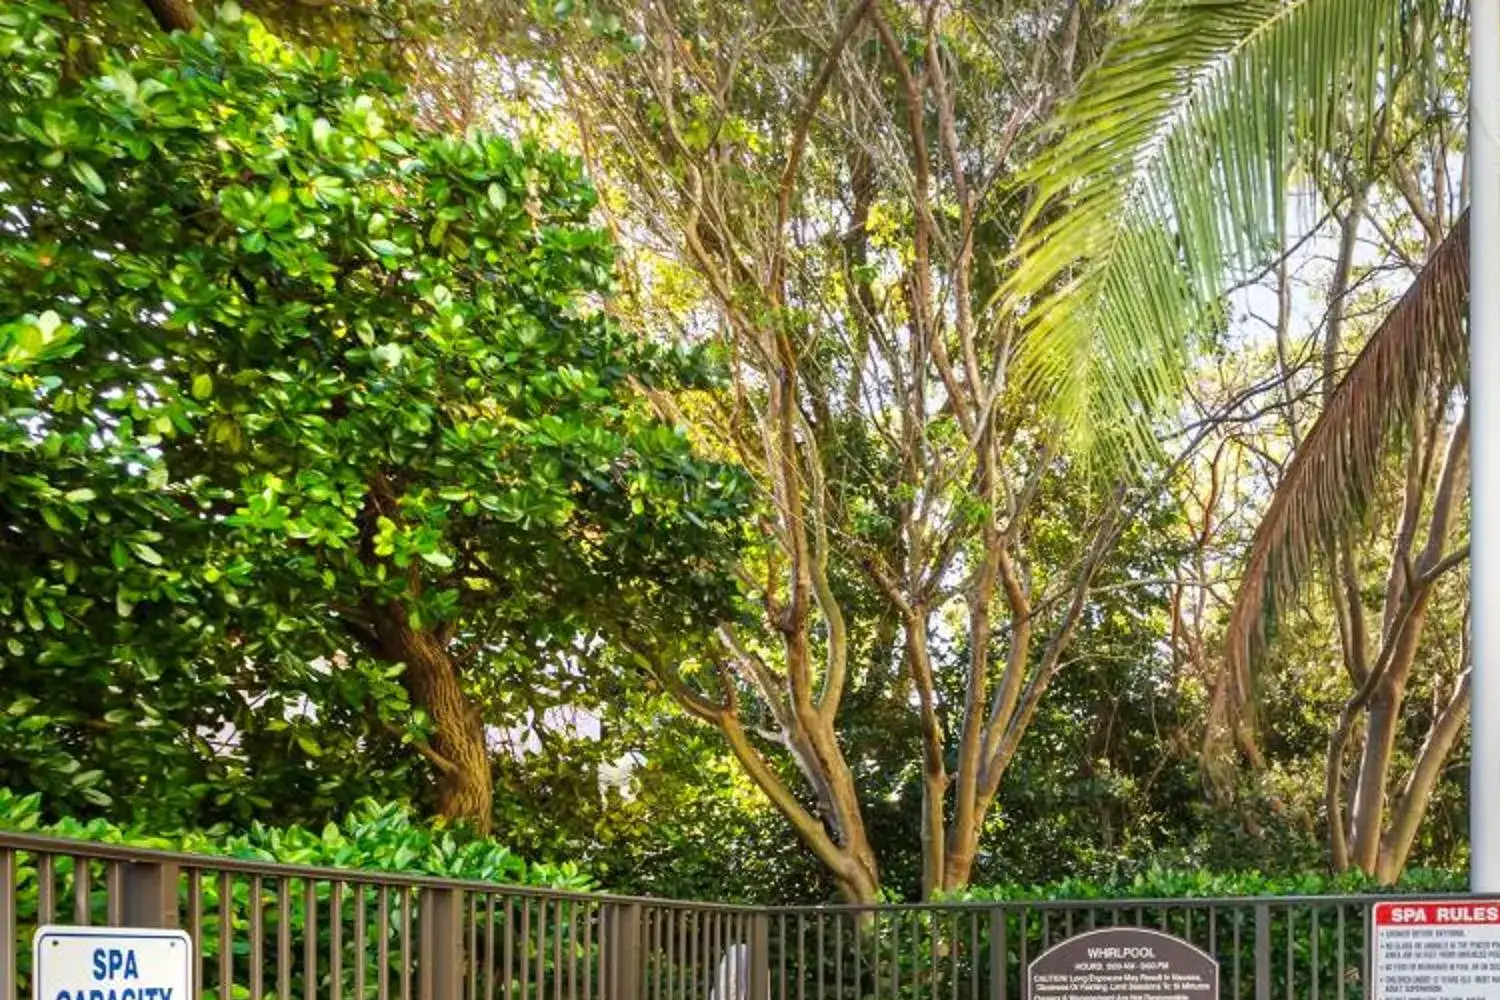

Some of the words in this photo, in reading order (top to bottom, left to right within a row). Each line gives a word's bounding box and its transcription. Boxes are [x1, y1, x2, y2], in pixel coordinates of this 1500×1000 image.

[1391, 908, 1426, 922] SPA
[1437, 907, 1499, 921] RULES
[1088, 948, 1156, 959] WHIRLPOOL
[93, 948, 138, 980] SPA
